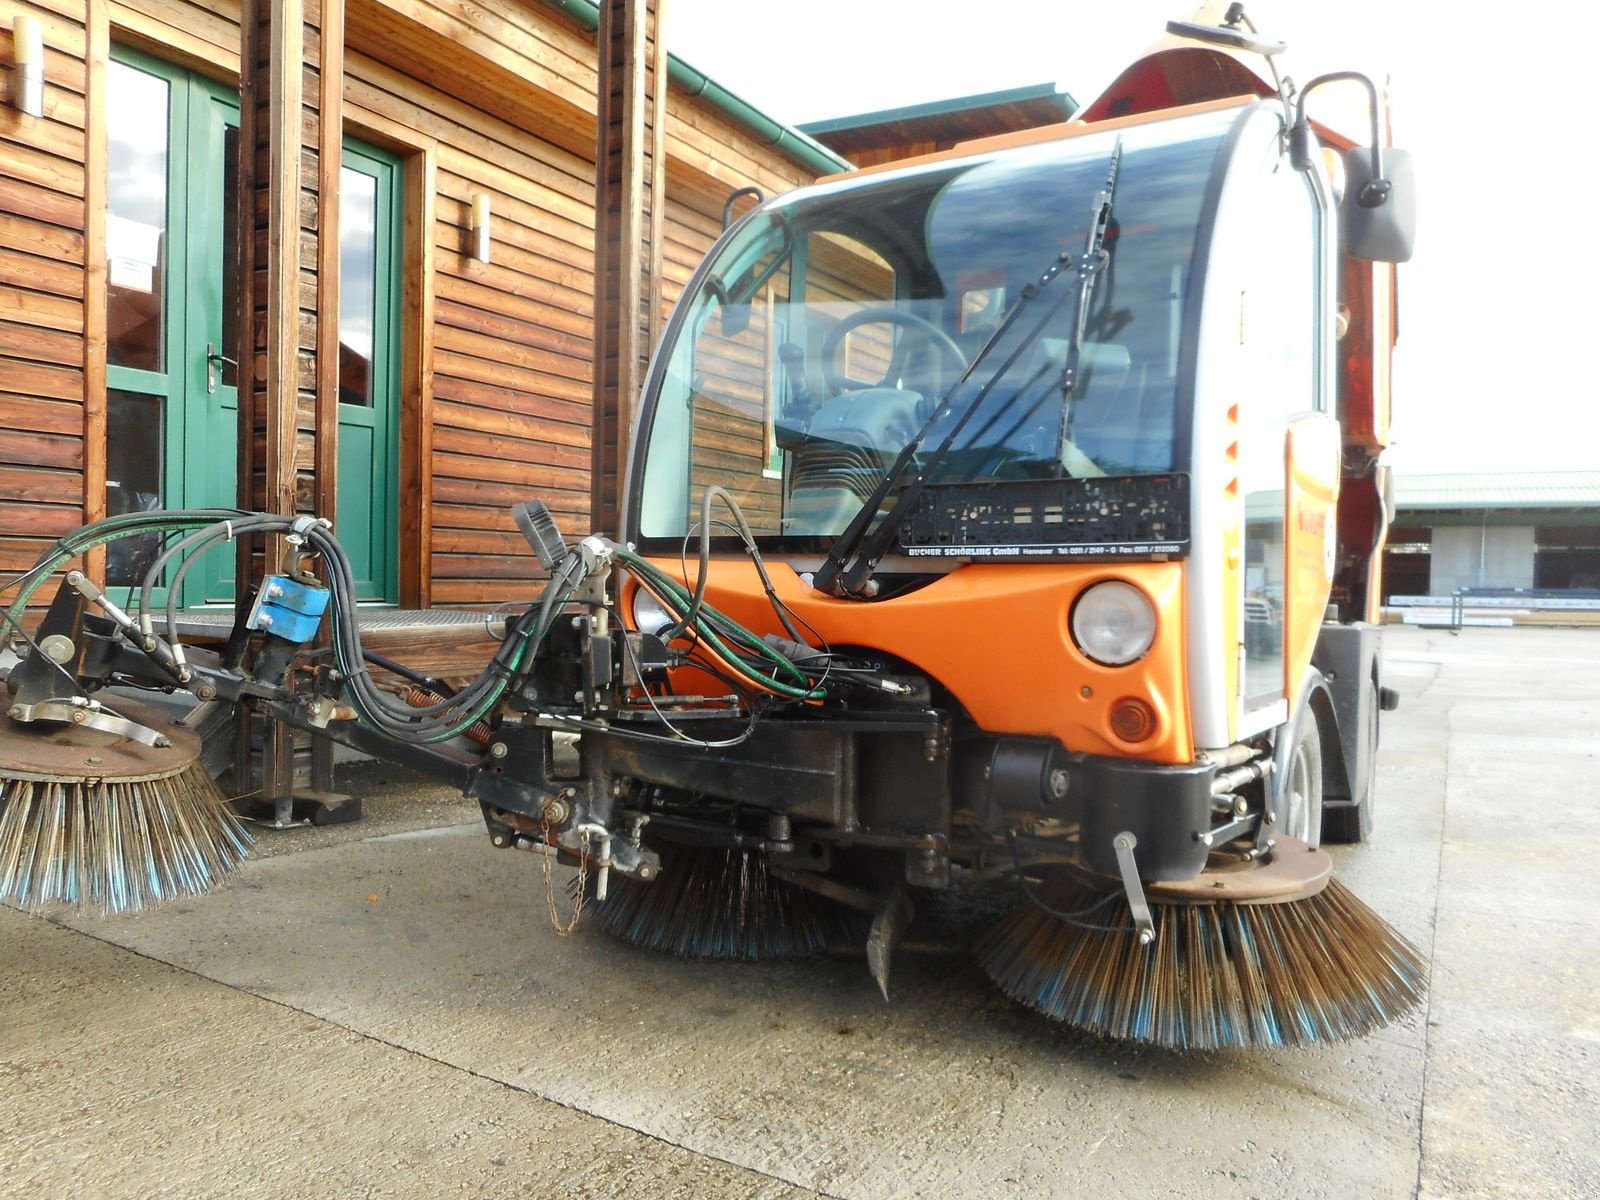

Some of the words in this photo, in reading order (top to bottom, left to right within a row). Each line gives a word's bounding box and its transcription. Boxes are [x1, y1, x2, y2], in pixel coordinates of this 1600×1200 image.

[909, 548, 942, 556] BUCHER
[944, 547, 992, 556] SCHÖRLING
[993, 547, 1020, 556] GmbH
